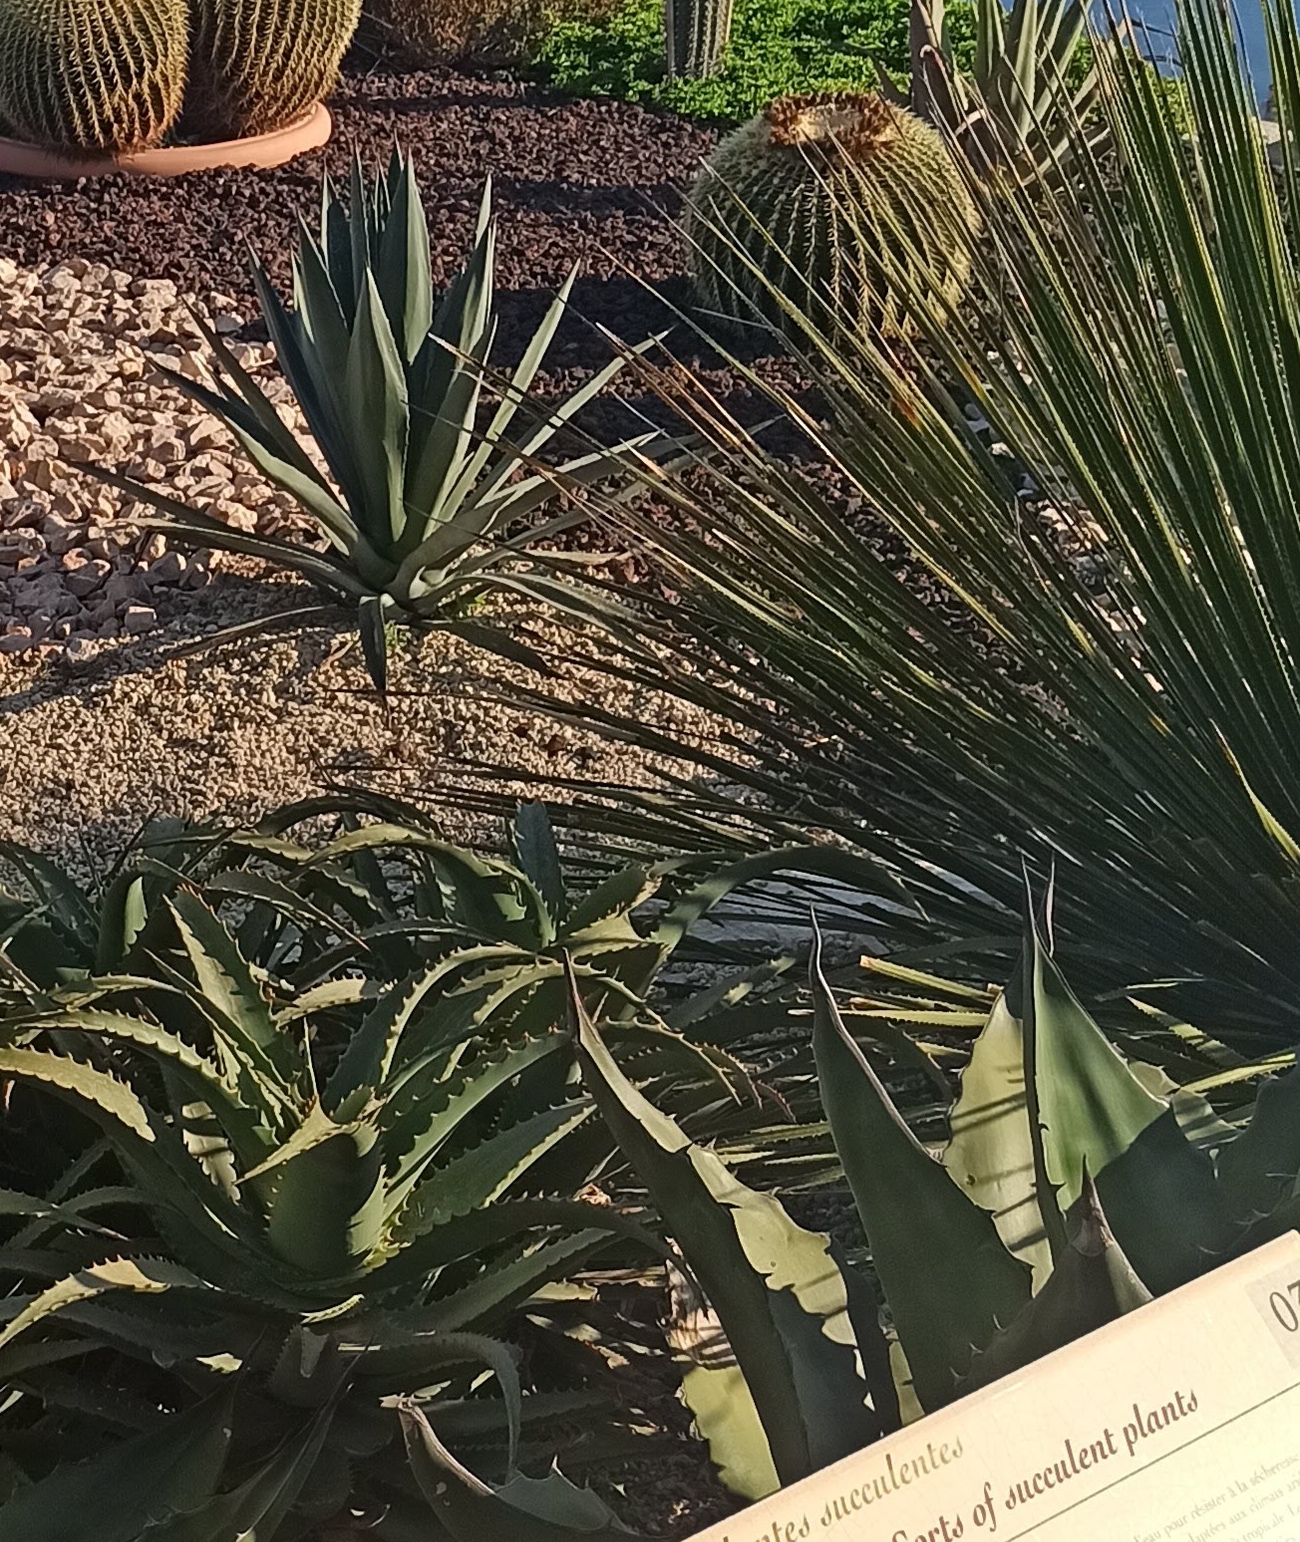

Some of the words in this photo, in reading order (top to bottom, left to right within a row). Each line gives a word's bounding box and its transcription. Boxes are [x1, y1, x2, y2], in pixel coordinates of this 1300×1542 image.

[819, 1435, 963, 1527] succulentes
[972, 1480, 997, 1532] of
[1004, 1427, 1118, 1510] succulent
[1121, 1388, 1198, 1457] plants
